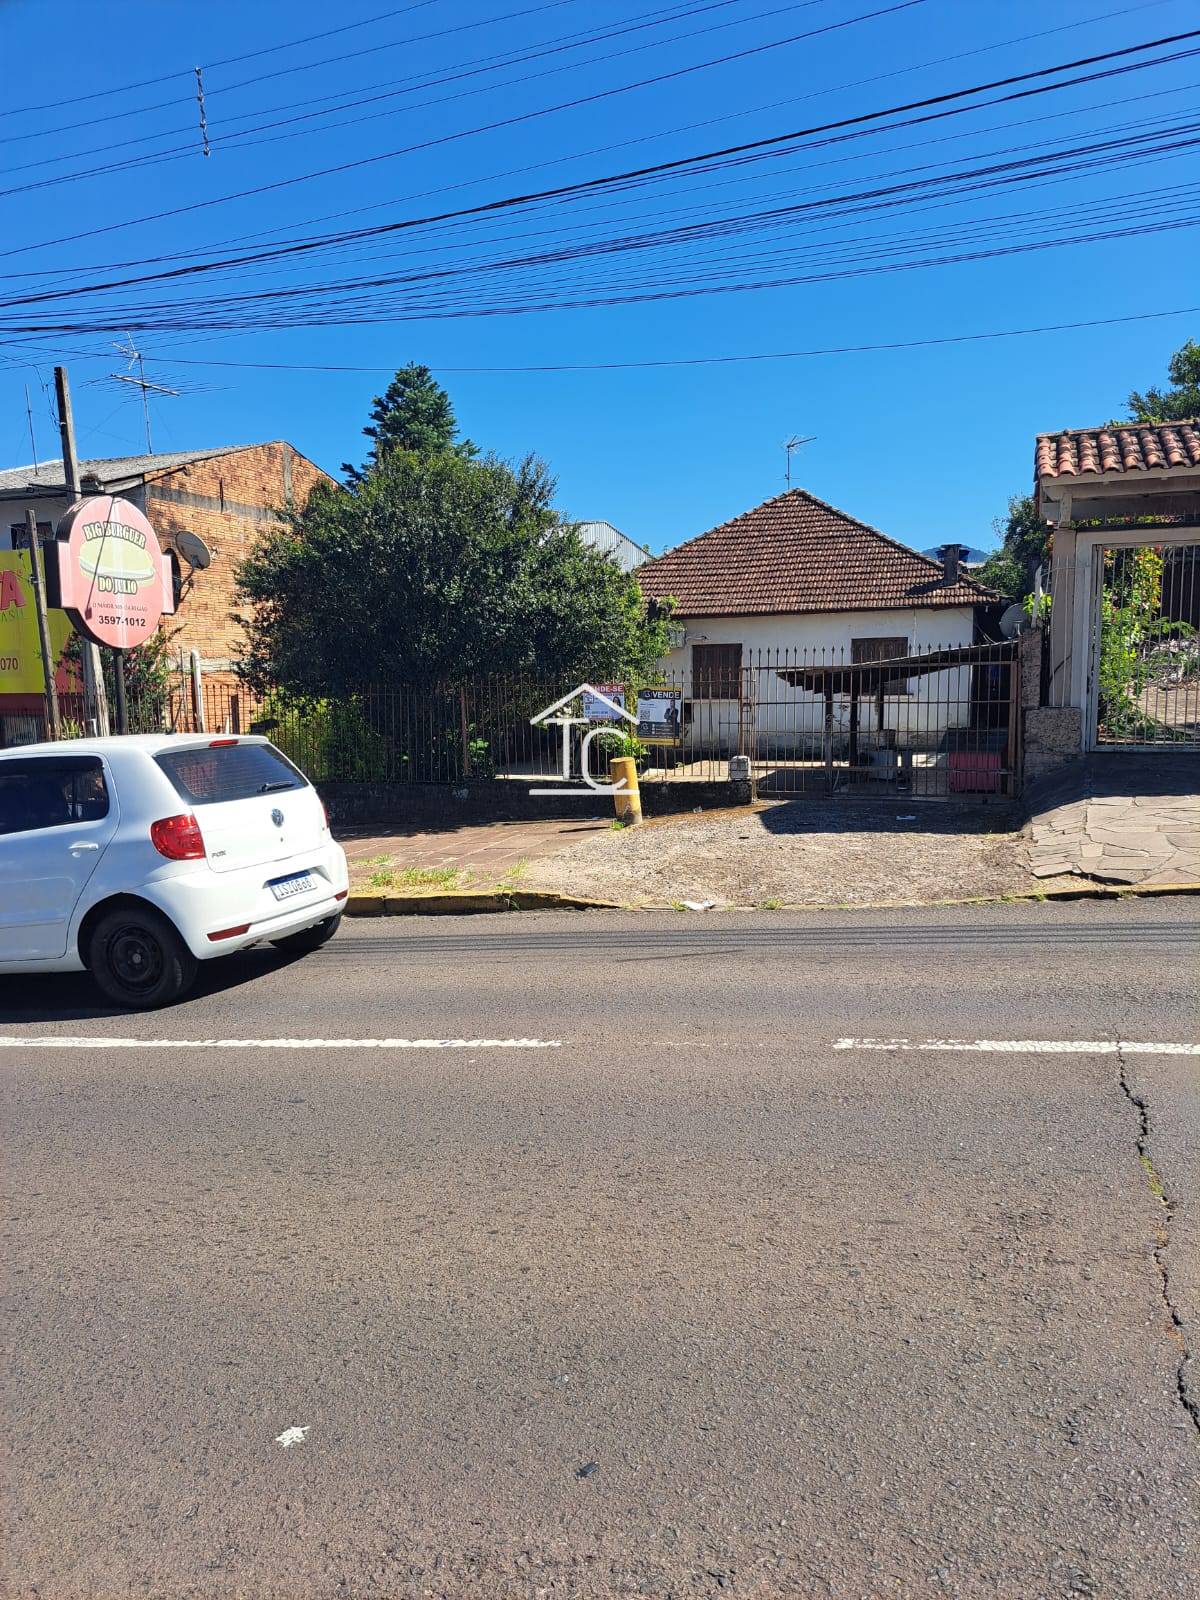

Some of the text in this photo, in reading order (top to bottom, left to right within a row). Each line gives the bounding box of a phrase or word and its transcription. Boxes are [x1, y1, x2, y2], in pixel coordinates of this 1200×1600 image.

[83, 521, 146, 548] BIG BURGUER
[98, 576, 138, 595] DO JULIO
[98, 615, 146, 627] 3597-1012
[652, 690, 680, 699] VENDE
